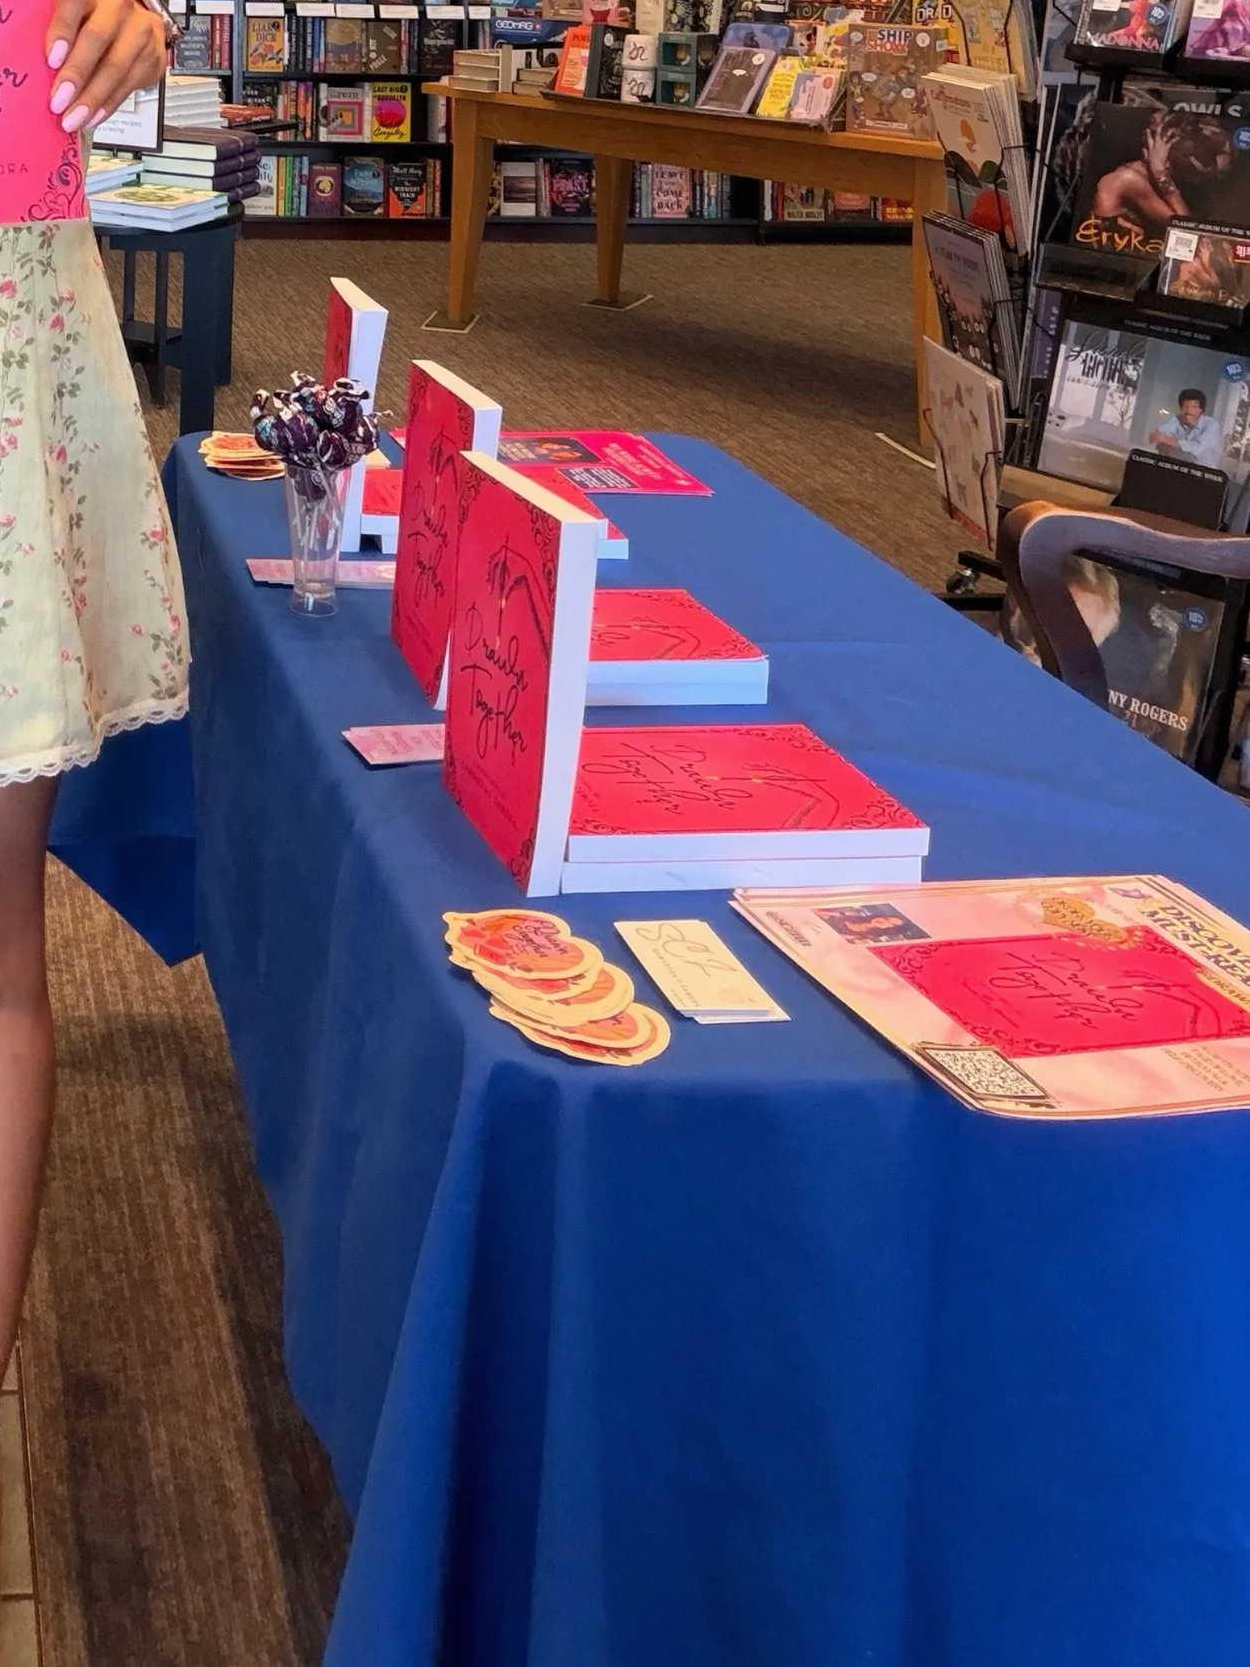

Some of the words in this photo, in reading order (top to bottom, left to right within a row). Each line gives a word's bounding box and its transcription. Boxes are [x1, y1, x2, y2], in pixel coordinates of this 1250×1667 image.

[495, 20, 534, 30] GEOMAG
[878, 29, 912, 41] SHIP
[1076, 215, 1163, 252] Eryka
[1171, 219, 1198, 228] CLASSIC
[1199, 223, 1221, 232] ALBUM
[1131, 453, 1156, 466] CLASSIC
[1157, 460, 1180, 472] ALBUM
[1180, 465, 1189, 473] OF
[1189, 467, 1203, 478] THE
[1203, 471, 1223, 483] WEEK
[1131, 696, 1190, 731] ROGERS
[1141, 909, 1250, 986] MUST-REA
[1159, 905, 1250, 971] DISCOVE
